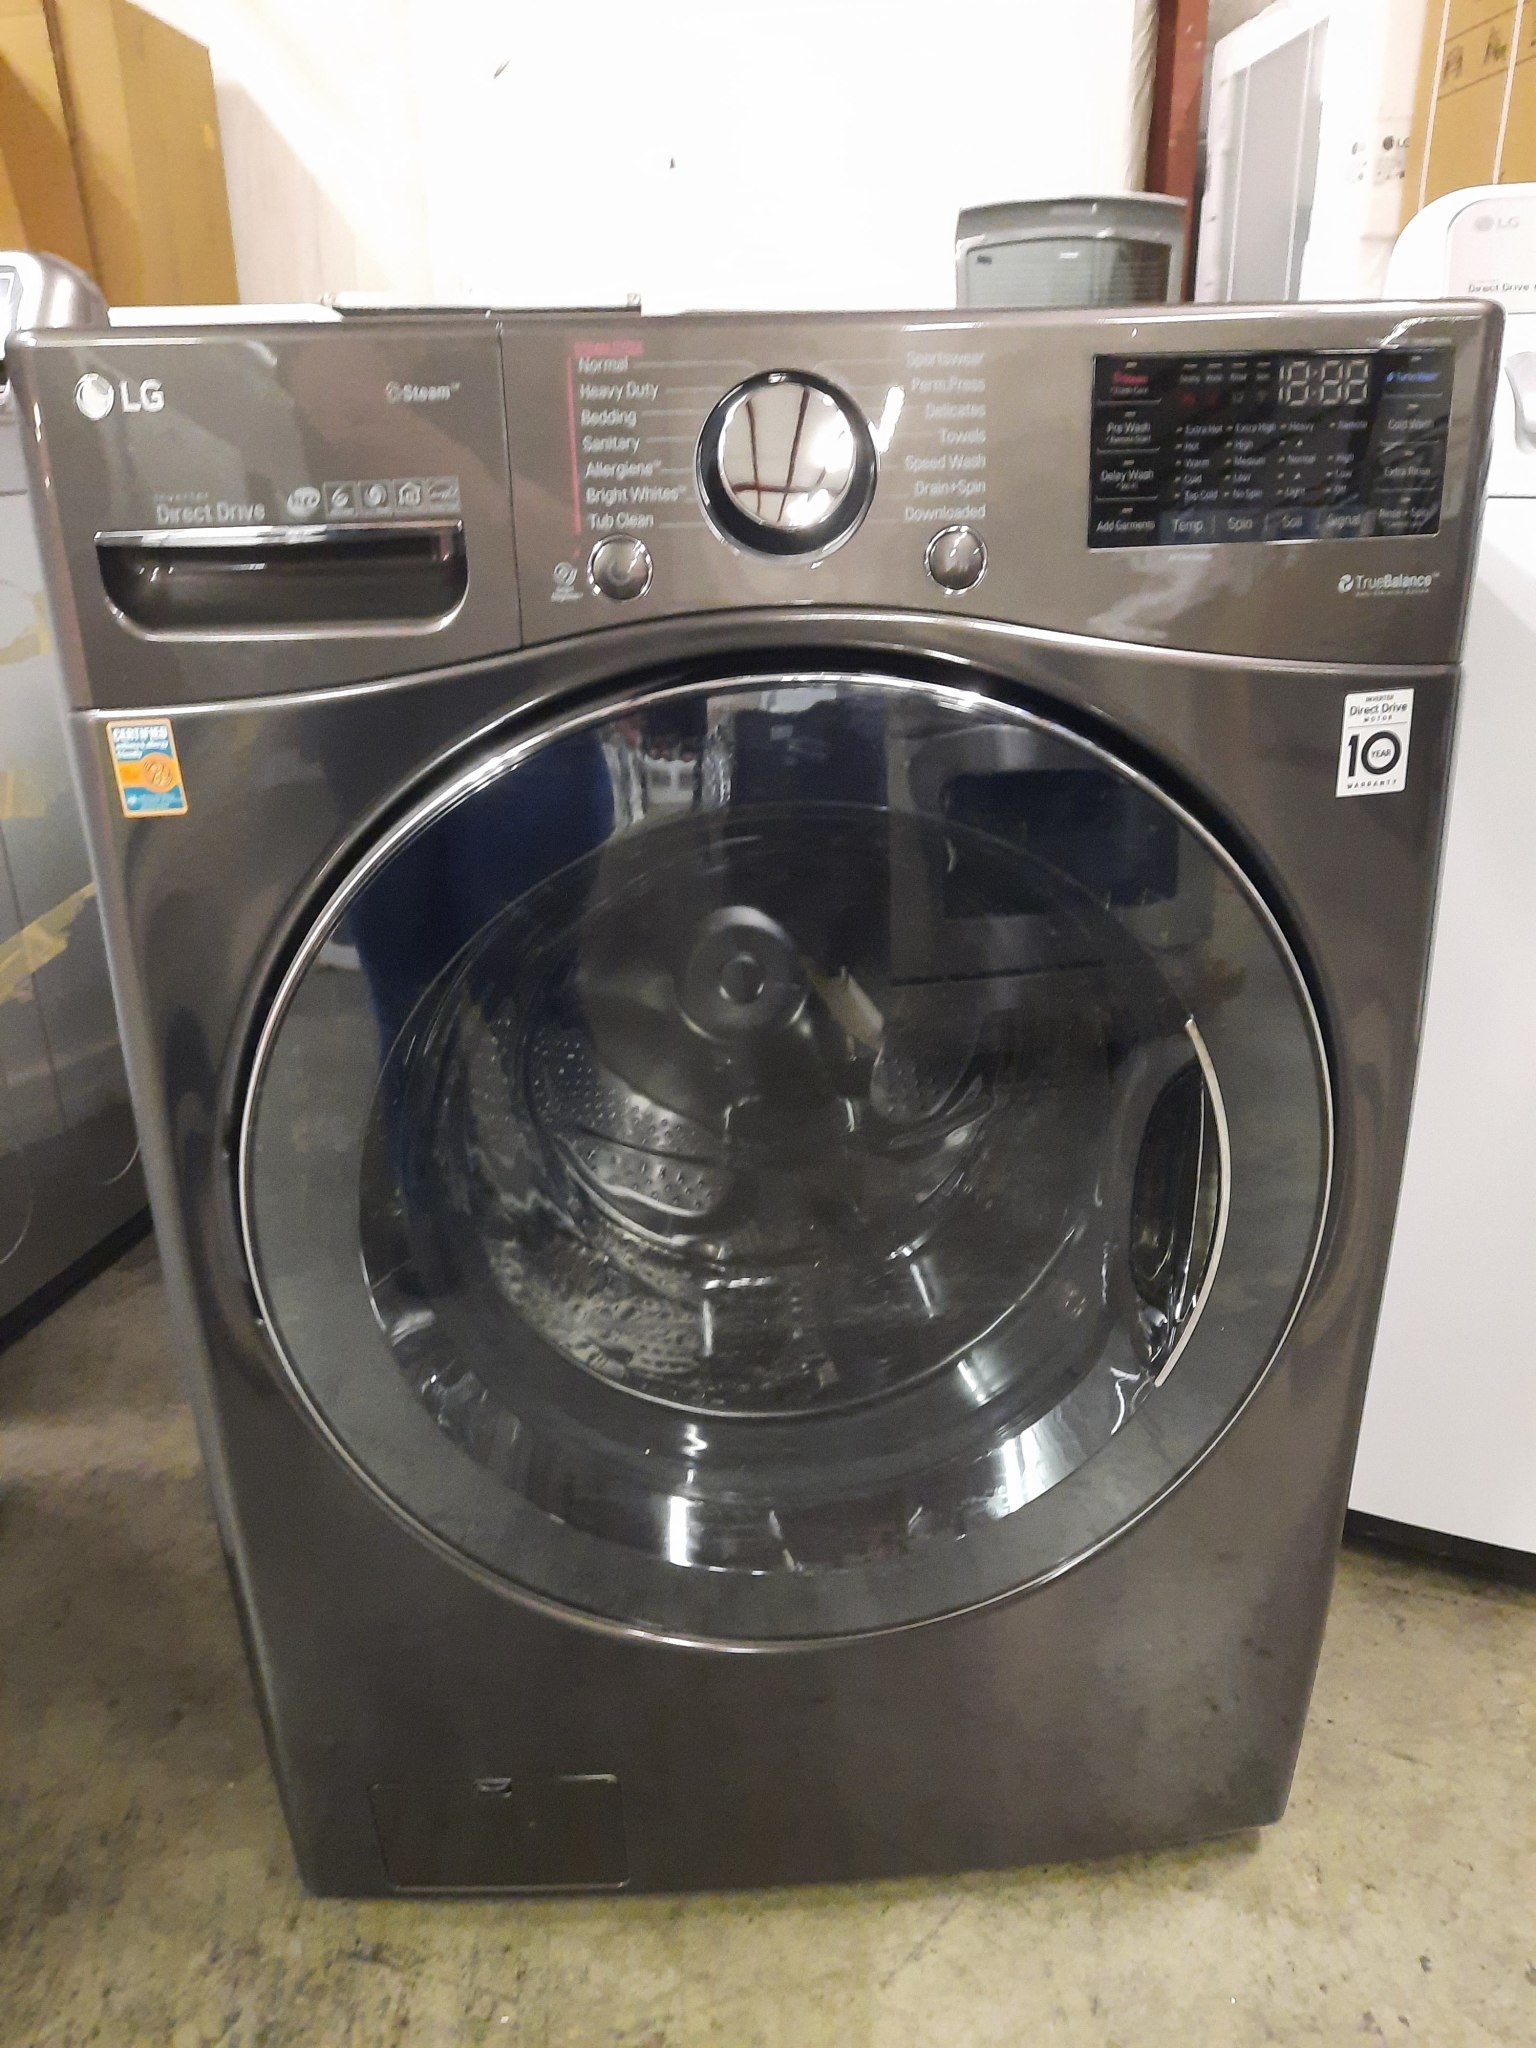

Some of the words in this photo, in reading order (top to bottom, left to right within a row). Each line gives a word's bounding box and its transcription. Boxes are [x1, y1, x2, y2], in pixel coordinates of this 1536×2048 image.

[1497, 216, 1520, 229] LG
[1468, 284, 1499, 293] Direct
[1503, 283, 1530, 292] Drive
[579, 355, 629, 373] Normal
[907, 351, 985, 368] Sportswear
[119, 378, 165, 413] LG
[581, 383, 624, 402] Heavy
[626, 381, 659, 401] Duty
[581, 409, 637, 428] Bedding
[926, 403, 986, 419] Delicates
[940, 427, 986, 444] Towels
[583, 435, 640, 454] Sanitary
[905, 454, 946, 472] Speed
[948, 454, 986, 470] Wash
[1101, 469, 1126, 482] Delay
[1128, 468, 1154, 481] Wash
[586, 487, 628, 506] Bright
[157, 504, 213, 524] Direct
[217, 500, 266, 522] Drive
[905, 504, 986, 520] Downloaded
[588, 512, 614, 531] Tub
[615, 511, 655, 530] Clean
[1096, 520, 1114, 532] Add
[1115, 520, 1156, 532] Garments
[1173, 519, 1204, 534] Temp
[1226, 517, 1253, 530] Spin
[1281, 514, 1303, 529] Soil
[1349, 704, 1379, 716] Direct
[1382, 702, 1408, 713] Drive
[1363, 715, 1393, 723] MOTOR
[1348, 730, 1401, 776] 10
[1371, 748, 1392, 759] YEAR
[1346, 778, 1398, 790] WARRANTY
